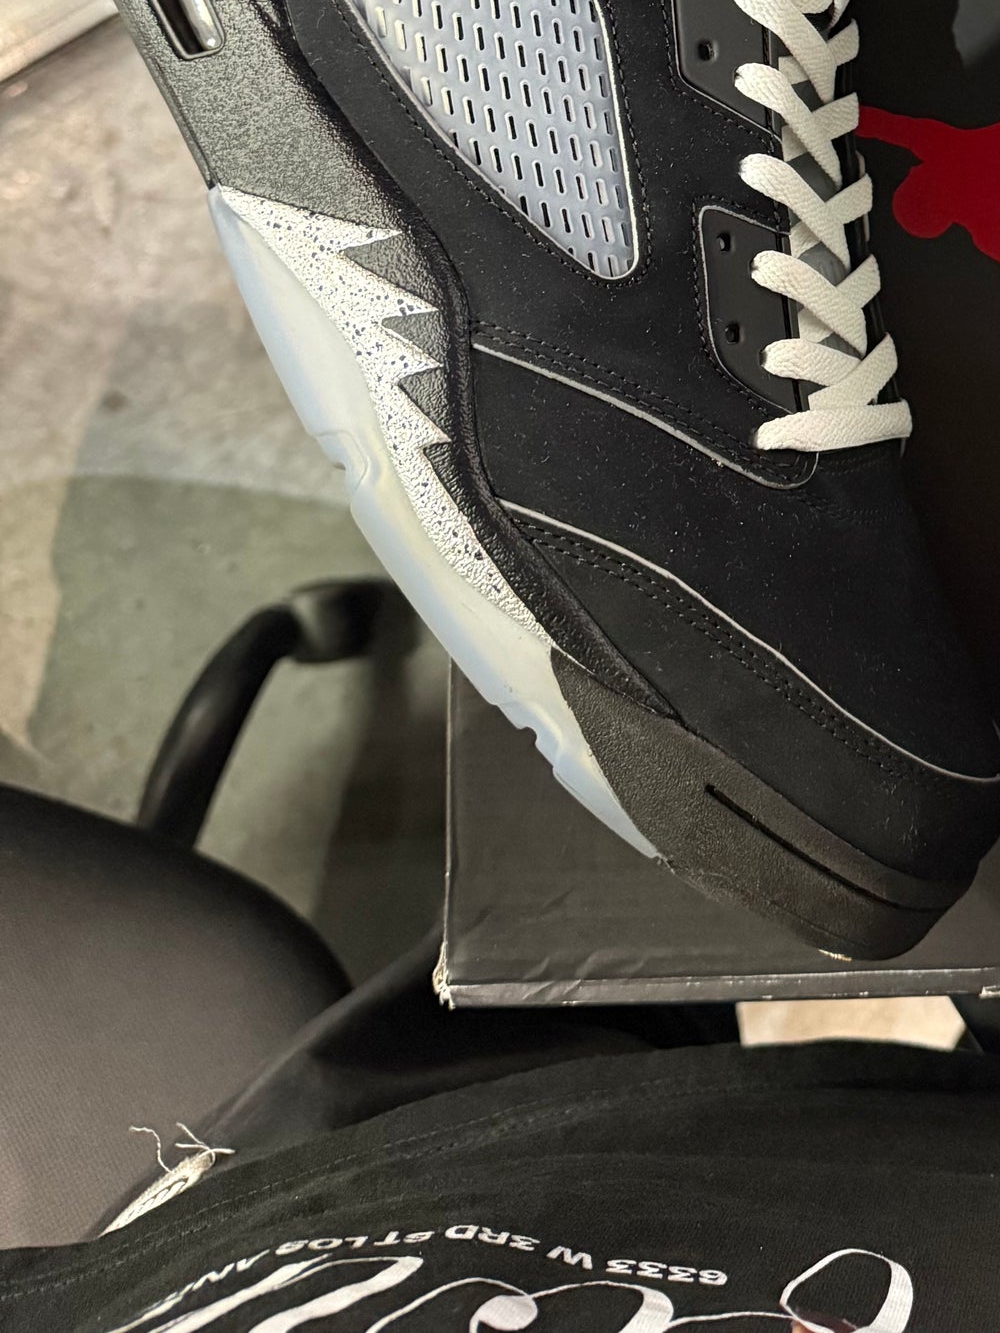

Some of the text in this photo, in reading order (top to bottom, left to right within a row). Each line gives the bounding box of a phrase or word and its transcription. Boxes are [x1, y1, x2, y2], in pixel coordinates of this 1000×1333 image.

[273, 1234, 369, 1256] LOS
[373, 1229, 436, 1247] ST
[444, 1223, 541, 1251] 3RD
[545, 1244, 593, 1270] W
[605, 1258, 728, 1286] 6333
